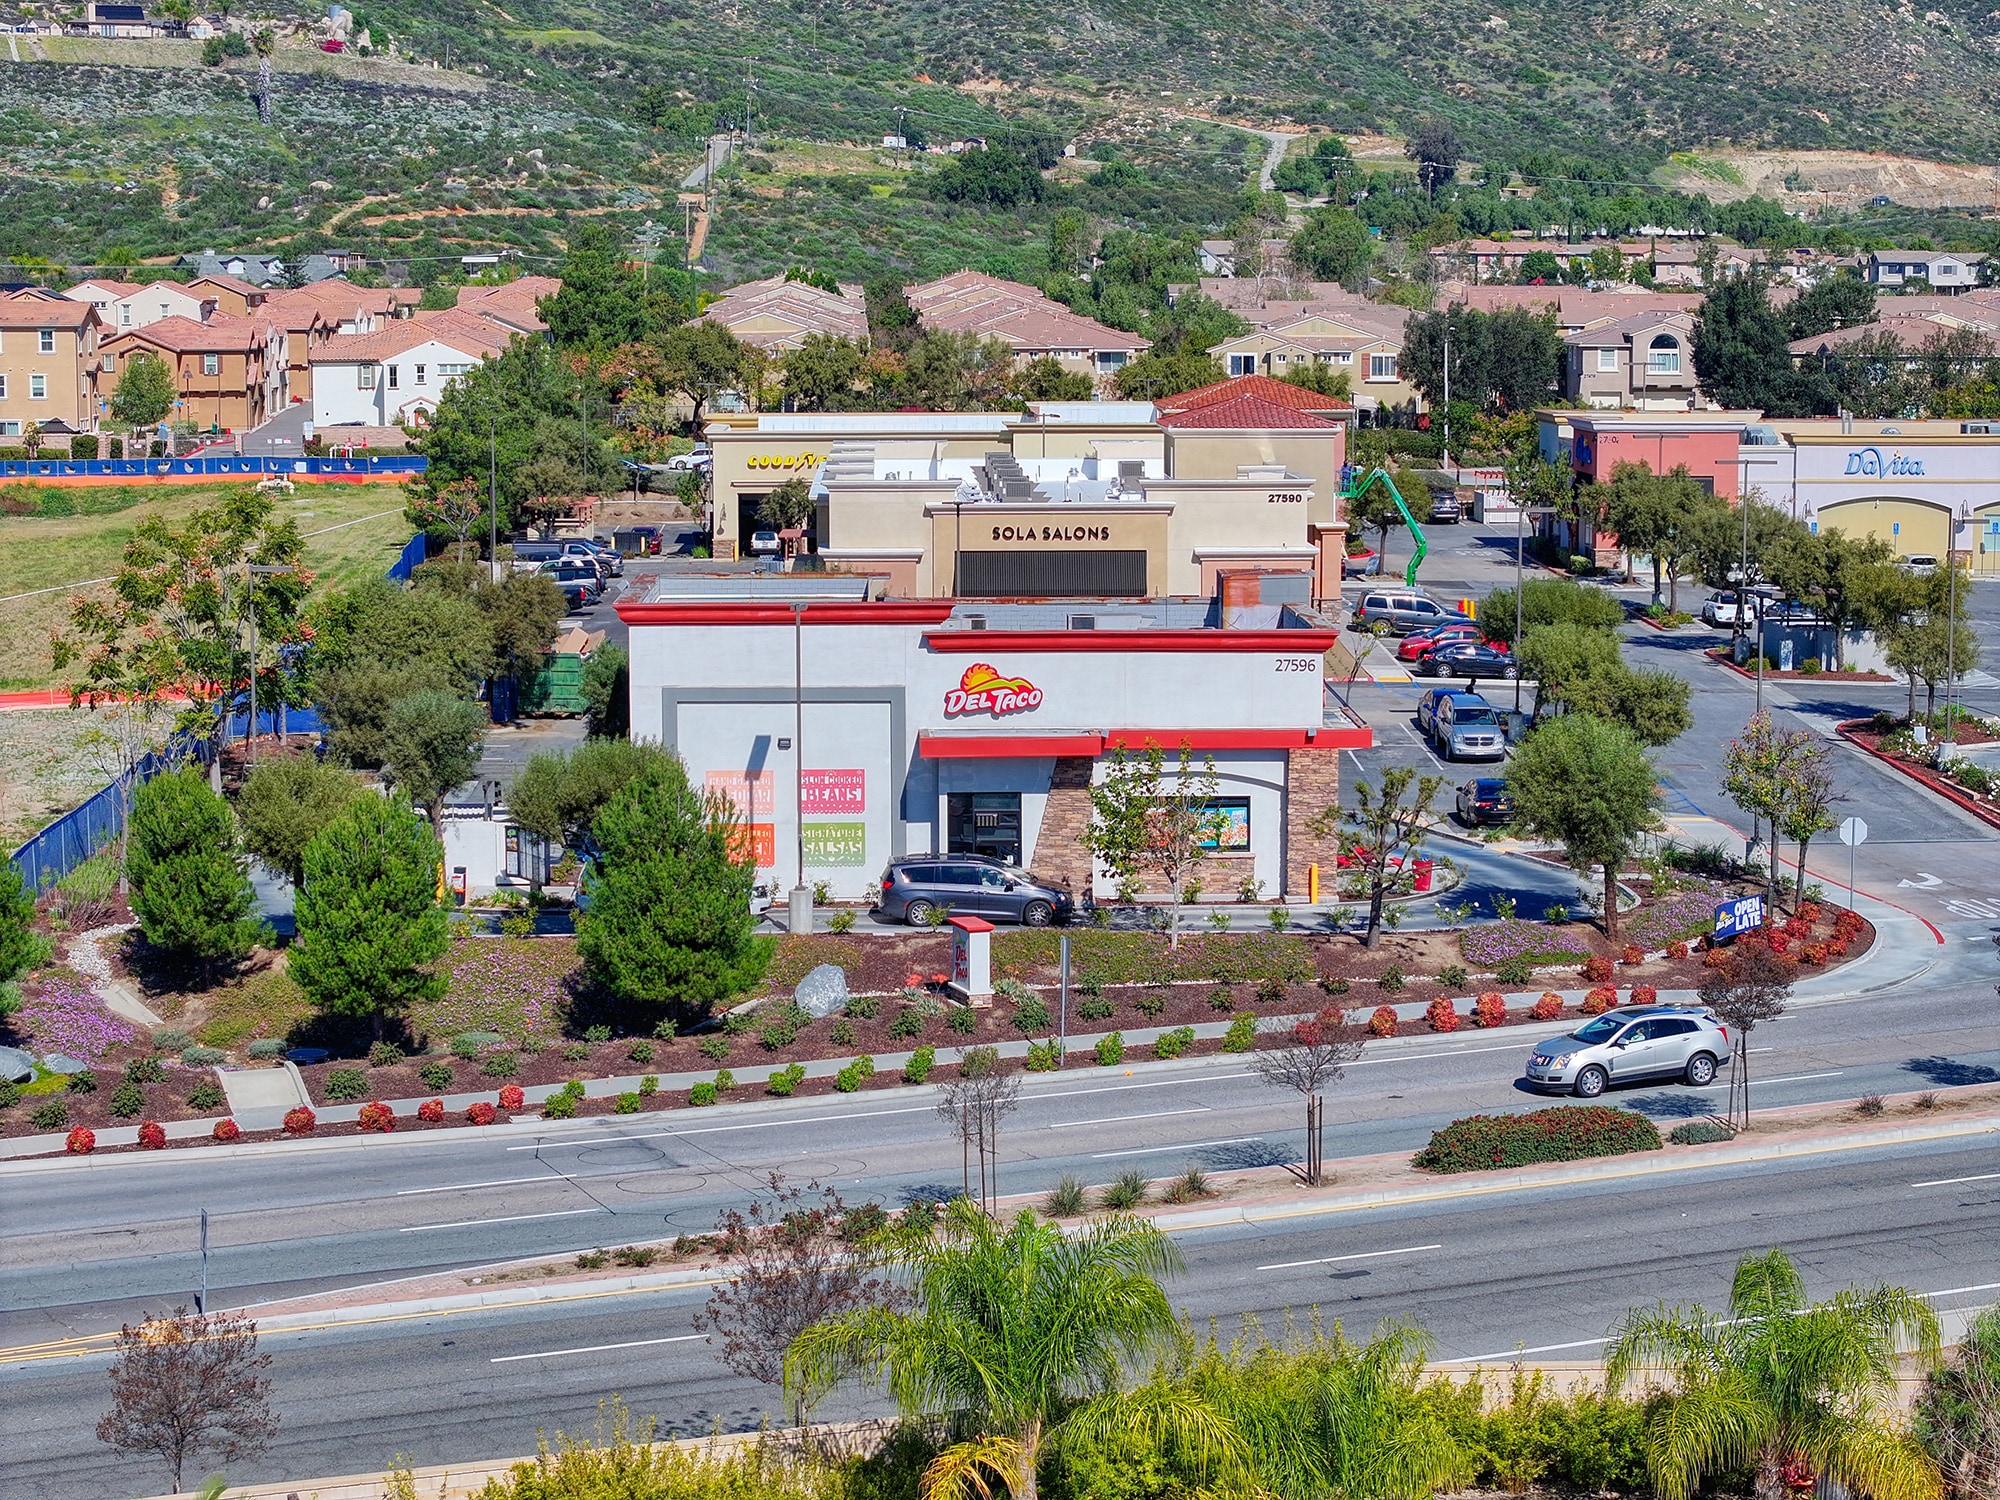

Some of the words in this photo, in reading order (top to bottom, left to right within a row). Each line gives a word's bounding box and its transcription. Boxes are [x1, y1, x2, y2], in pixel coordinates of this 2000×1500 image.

[1268, 494, 1302, 503] 27590
[992, 526, 1037, 541] SOLA
[1042, 526, 1110, 541] SALONS
[1275, 659, 1316, 672] 27596
[947, 690, 991, 713] DEL
[991, 688, 1042, 713] TACO
[828, 776, 862, 785] COOKED
[804, 788, 860, 801] BEANS
[801, 829, 863, 838] SIGNATURE
[801, 841, 863, 855] SALSAS
[1734, 897, 1760, 916] OPEN
[1735, 910, 1761, 931] LATE
